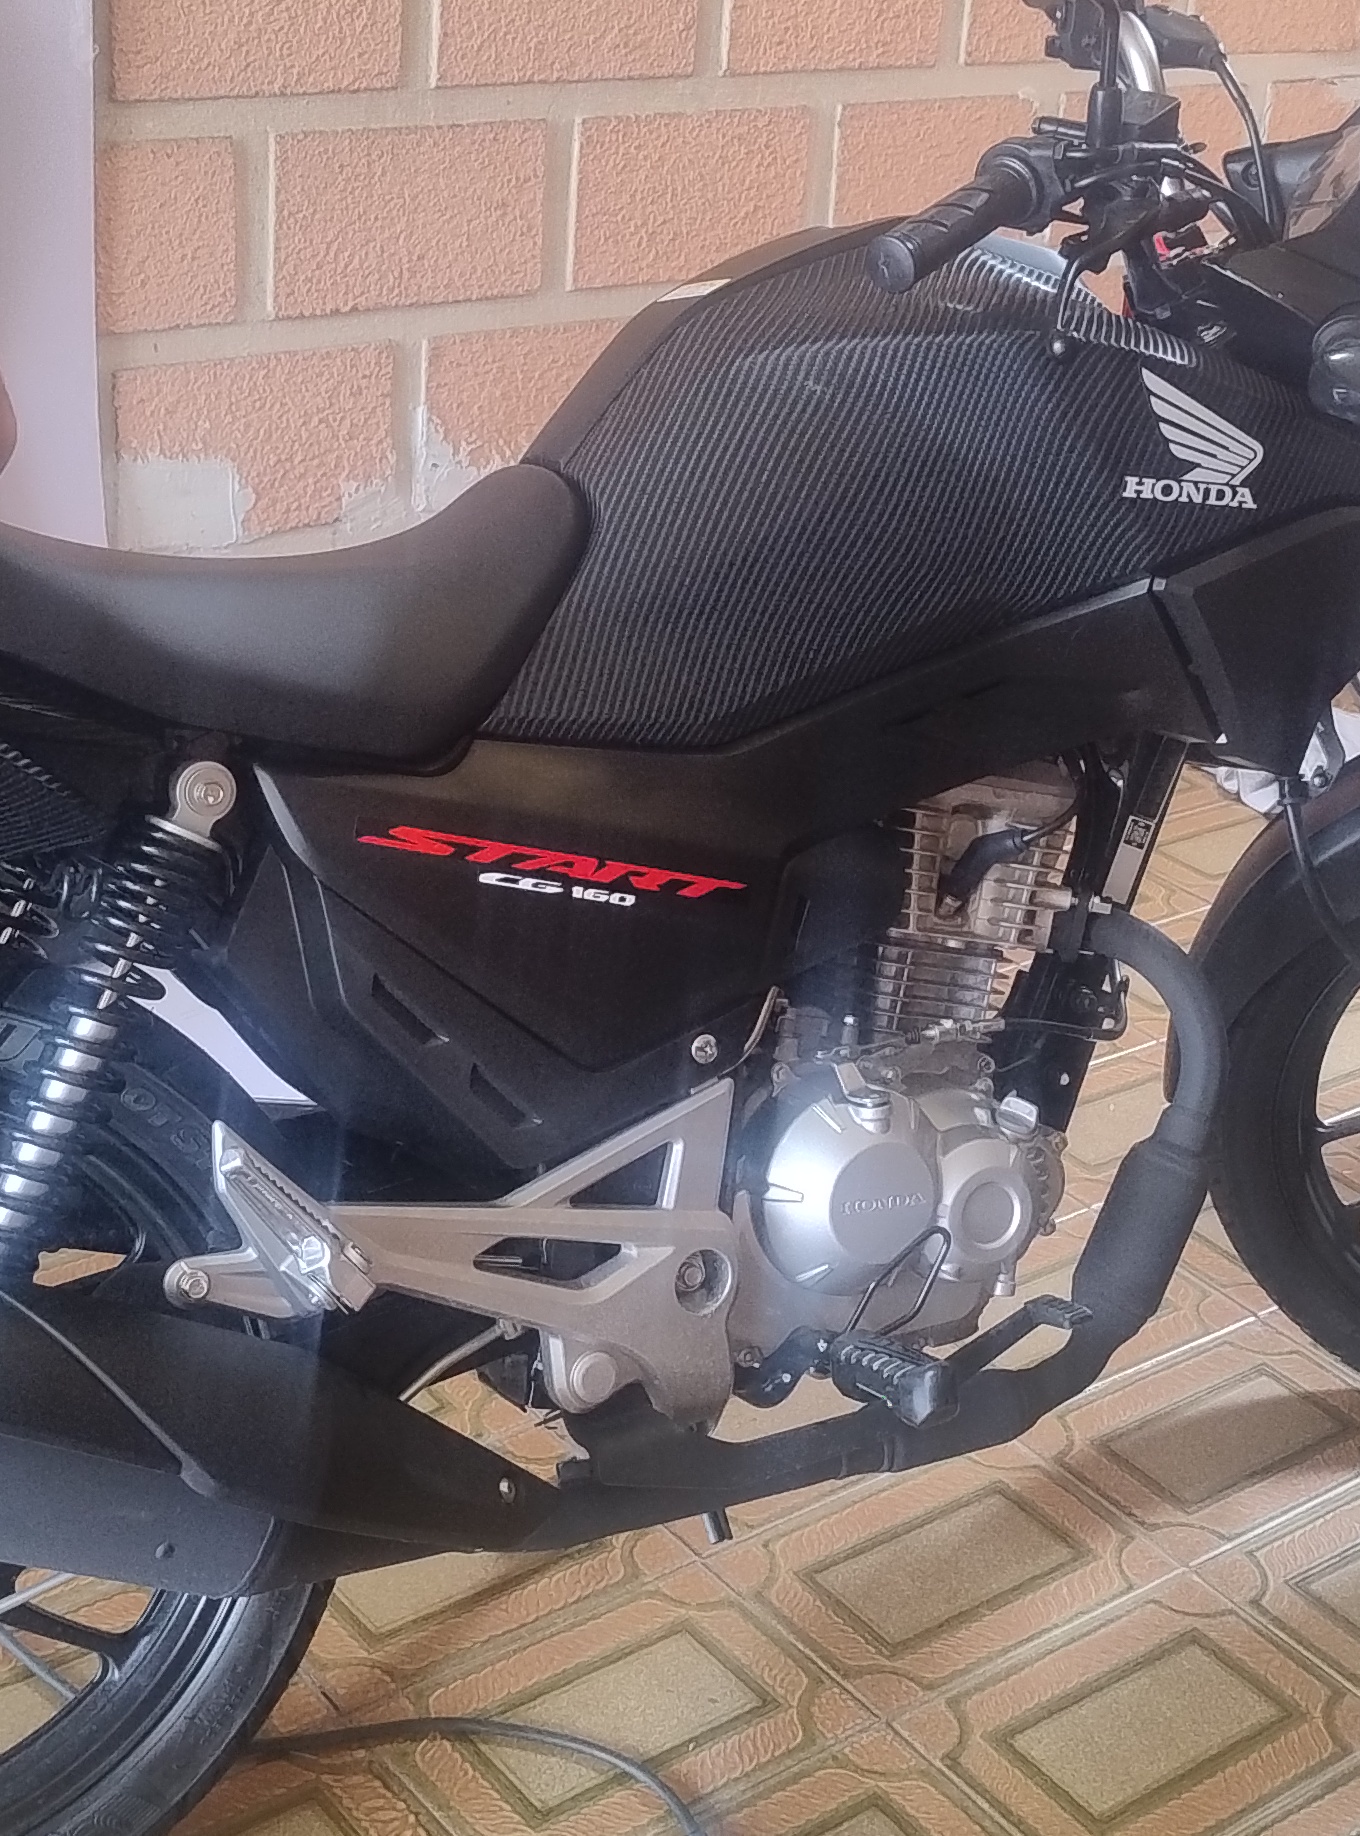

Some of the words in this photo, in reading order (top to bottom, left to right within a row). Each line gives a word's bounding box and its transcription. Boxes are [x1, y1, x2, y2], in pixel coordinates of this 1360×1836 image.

[1121, 475, 1258, 509] HONDA
[357, 825, 748, 898] START
[478, 872, 564, 894] CG
[571, 885, 637, 907] 160
[840, 1192, 927, 1216] HONDA
